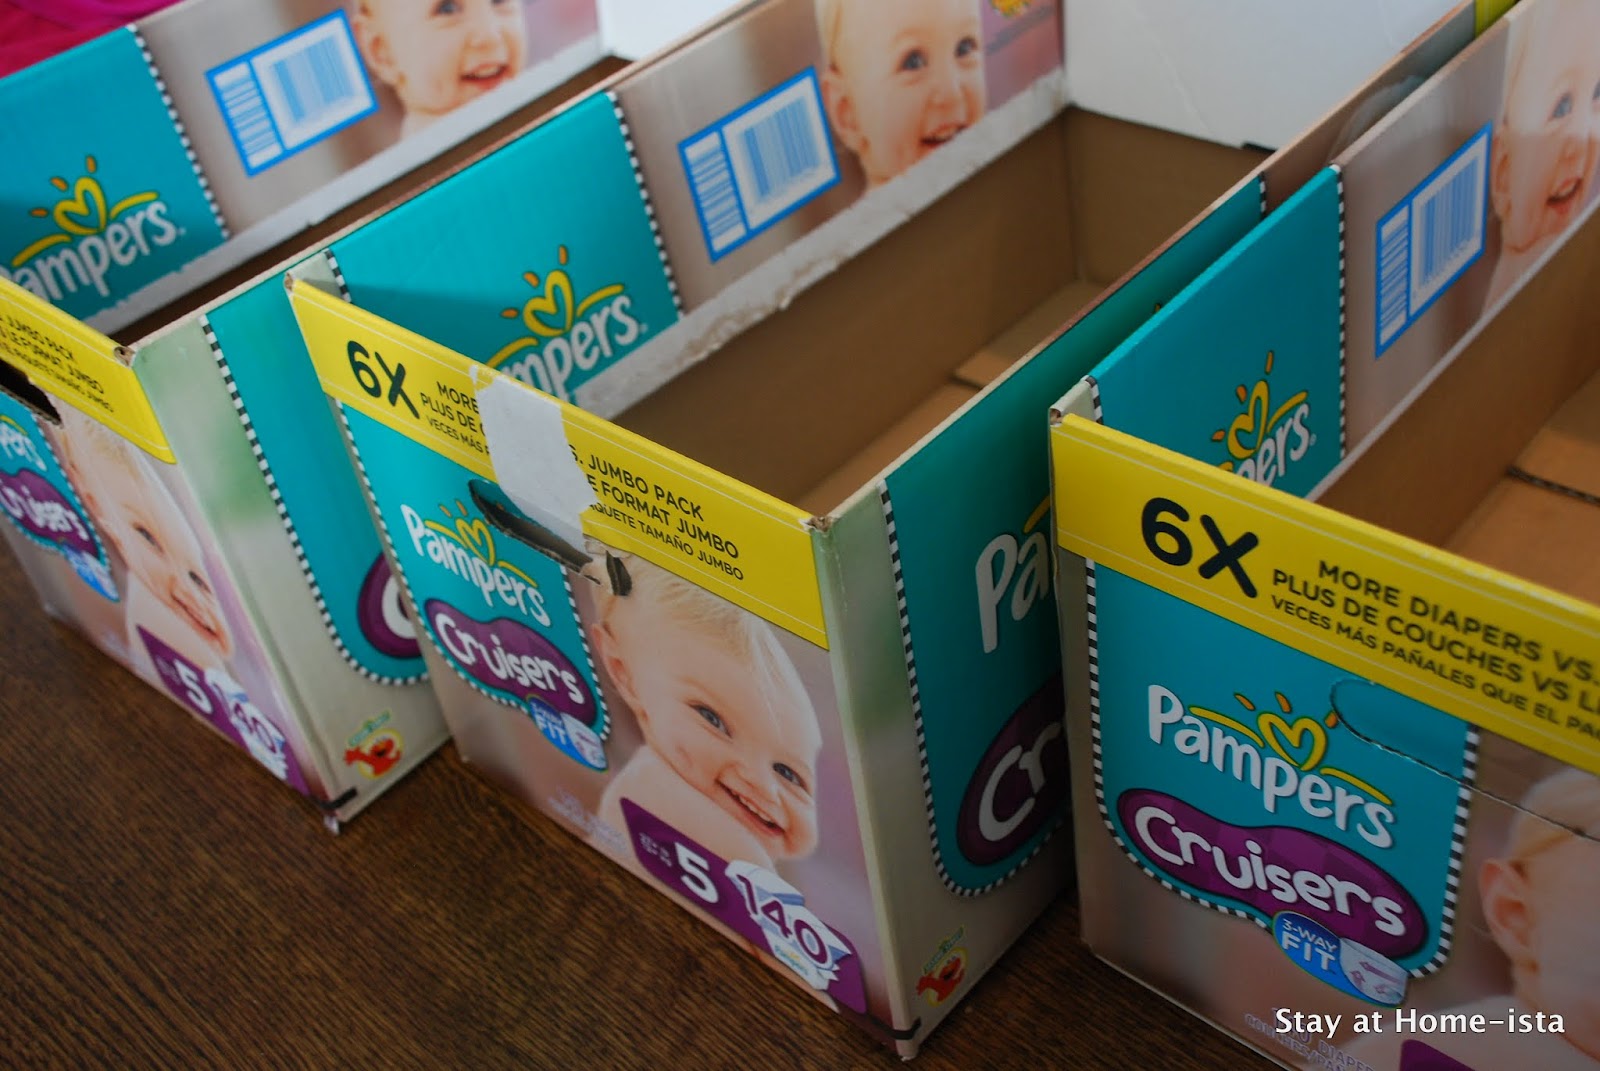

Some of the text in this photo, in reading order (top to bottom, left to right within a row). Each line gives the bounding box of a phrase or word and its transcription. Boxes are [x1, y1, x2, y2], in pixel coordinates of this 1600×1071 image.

[347, 341, 420, 419] 6X
[420, 392, 455, 421] PLUS
[457, 411, 478, 433] DE
[436, 381, 479, 414] MORE
[426, 415, 460, 441] VECES
[460, 433, 484, 453] MÁS
[589, 455, 649, 495] JUMBO
[654, 484, 704, 521] PACK
[601, 480, 670, 526] FORMAT
[677, 518, 739, 559] JUMBO
[400, 504, 551, 627] Pampers
[638, 520, 694, 556] TAMAÑO
[697, 550, 744, 581] JUMBO
[1141, 497, 1259, 598] 6X
[1273, 569, 1335, 609] PLUS
[1343, 597, 1379, 628] DE
[1386, 616, 1523, 682] COUCHES
[1531, 670, 1569, 702] VS
[1319, 560, 1403, 608] MORE
[1410, 596, 1544, 661] DIAPERS
[174, 660, 213, 714] 5
[435, 613, 585, 704] Cruisers
[1271, 595, 1331, 631] VECES
[1336, 619, 1377, 650] MÁS
[1382, 641, 1476, 690] PAÑALES
[1481, 681, 1526, 711] QUE
[1533, 702, 1560, 725] EL
[1148, 684, 1395, 848] Pampers
[675, 841, 718, 903] 5
[736, 874, 829, 964] 140
[1135, 806, 1406, 936] Cruisers
[1281, 930, 1336, 970] FIT
[1282, 918, 1338, 952] 3-WAY
